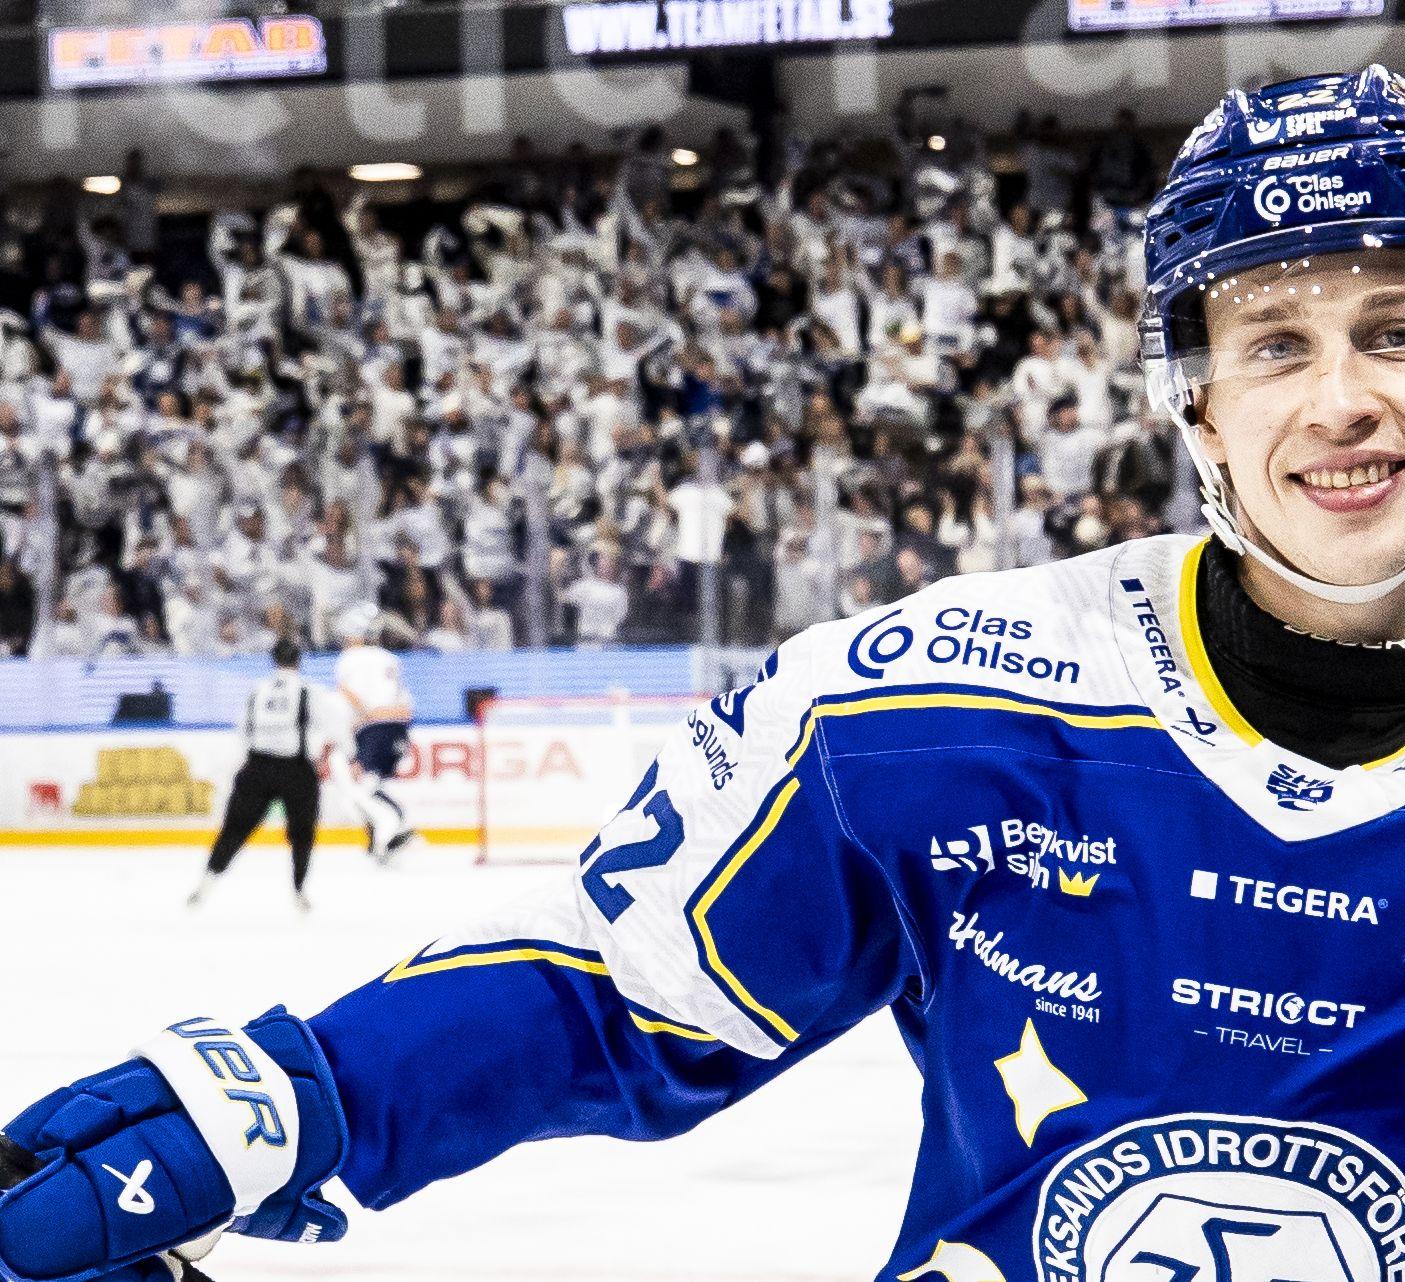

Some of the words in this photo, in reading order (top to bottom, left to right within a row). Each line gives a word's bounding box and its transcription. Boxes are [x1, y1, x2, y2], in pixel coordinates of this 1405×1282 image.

[1294, 174, 1344, 194] Clas
[1297, 190, 1372, 213] Ohlson
[935, 607, 1032, 641] Clas
[926, 635, 1080, 685] Ohlson
[1034, 996, 1067, 1018] since
[1070, 1002, 1101, 1024] 1941
[1215, 1026, 1311, 1056] TRAVEL
